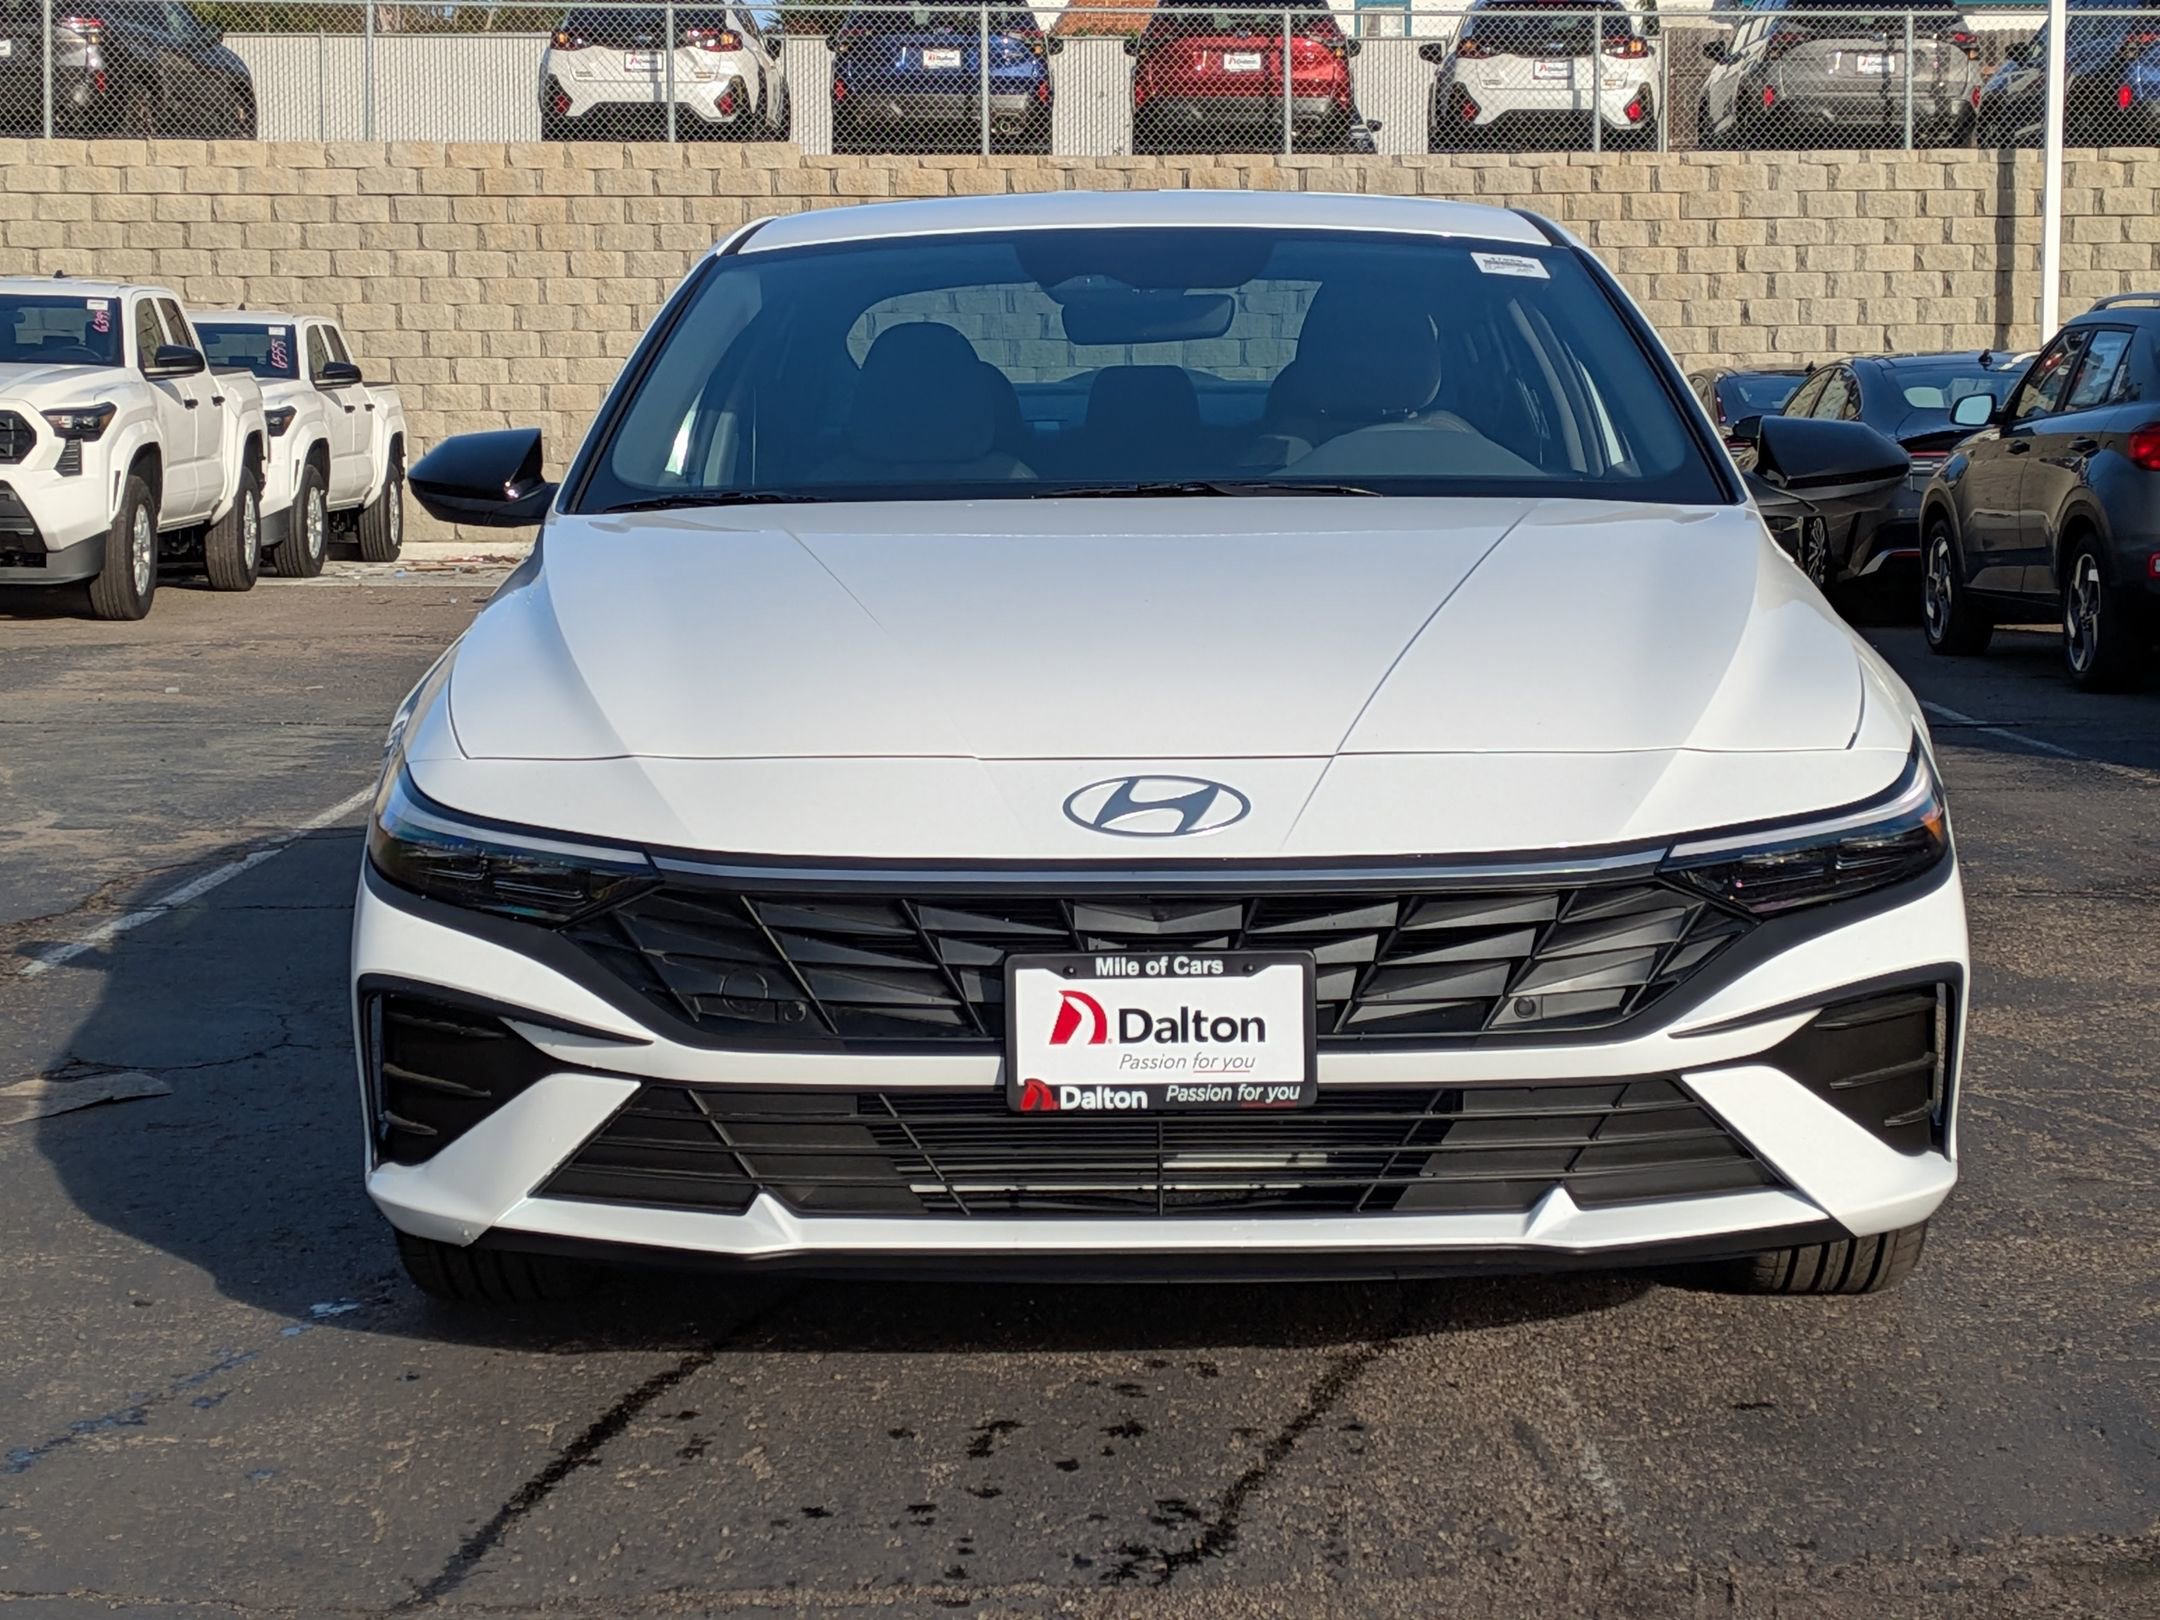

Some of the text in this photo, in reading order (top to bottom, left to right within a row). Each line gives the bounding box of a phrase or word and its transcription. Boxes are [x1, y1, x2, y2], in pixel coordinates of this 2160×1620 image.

[1095, 955, 1224, 976] Mile of Cars
[1118, 1006, 1266, 1044] Dalton
[1119, 1051, 1256, 1073] Passion for you
[1060, 1085, 1148, 1110] Dalton
[1165, 1083, 1300, 1104] Passion for you
